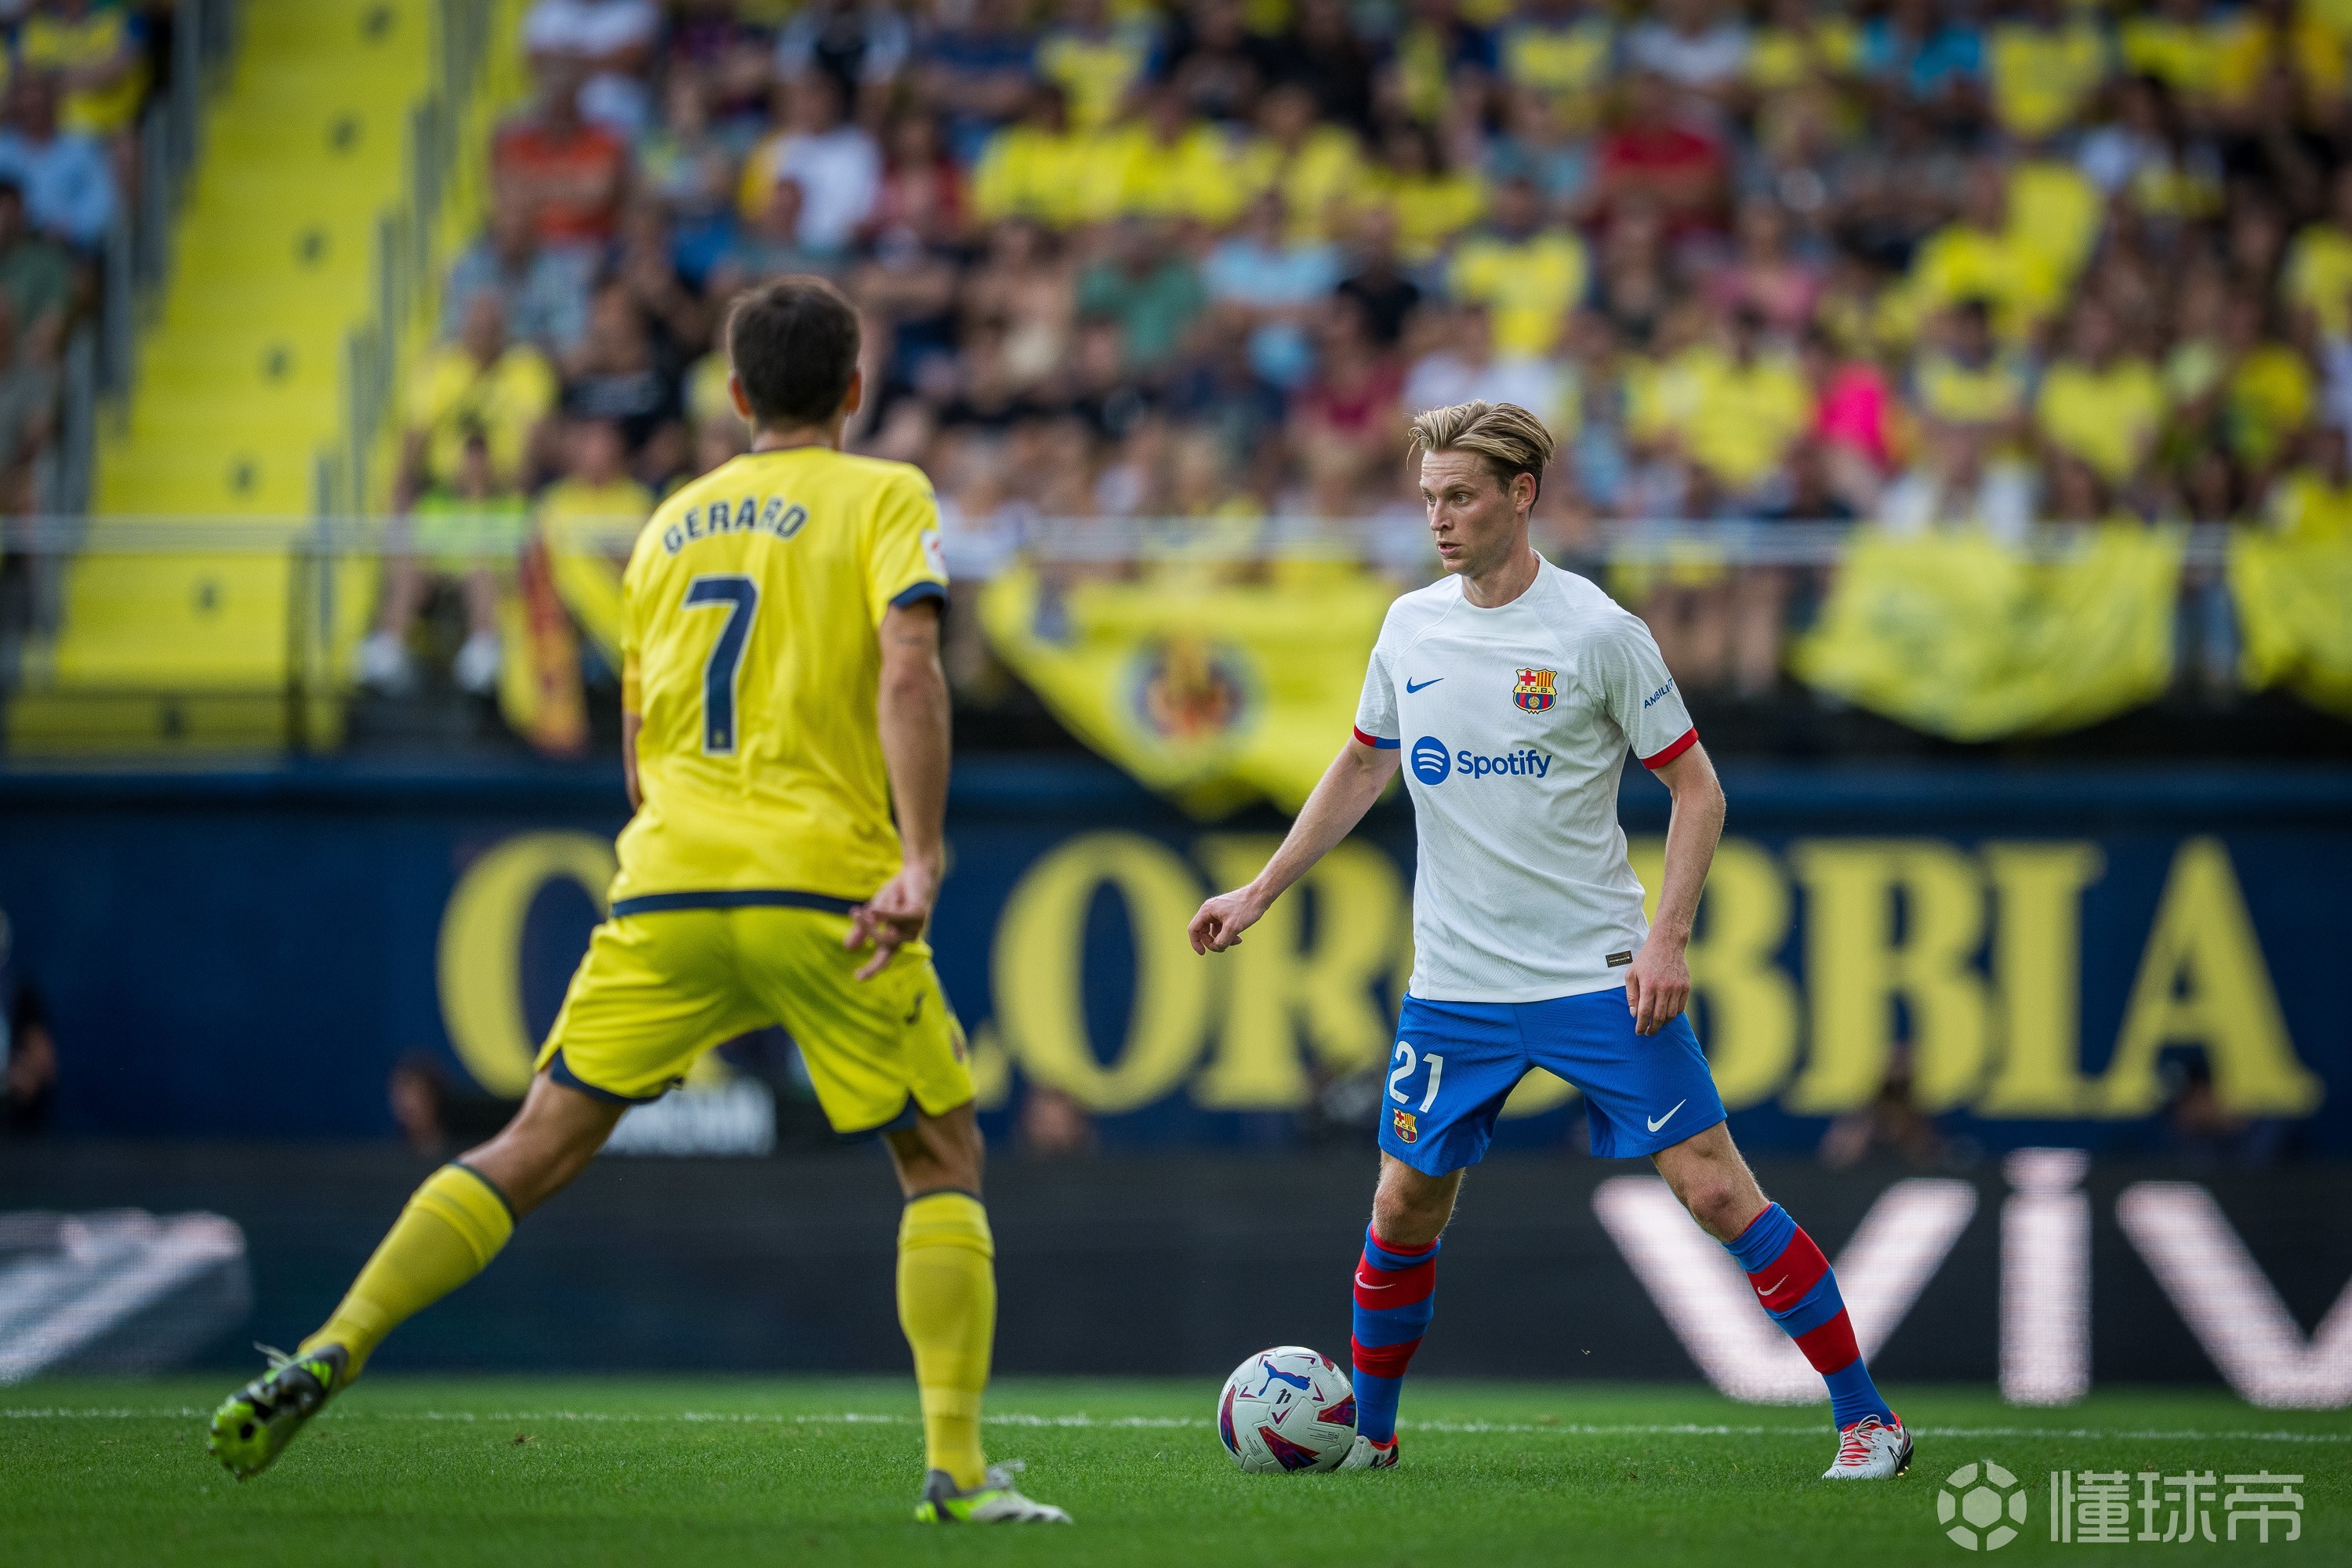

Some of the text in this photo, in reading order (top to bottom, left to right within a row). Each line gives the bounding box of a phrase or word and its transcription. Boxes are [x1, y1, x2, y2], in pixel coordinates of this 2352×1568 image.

[662, 495, 809, 557] GERARD
[682, 572, 760, 757] 7
[1457, 750, 1552, 779] Spotify
[1388, 1040, 1443, 1113] 21
